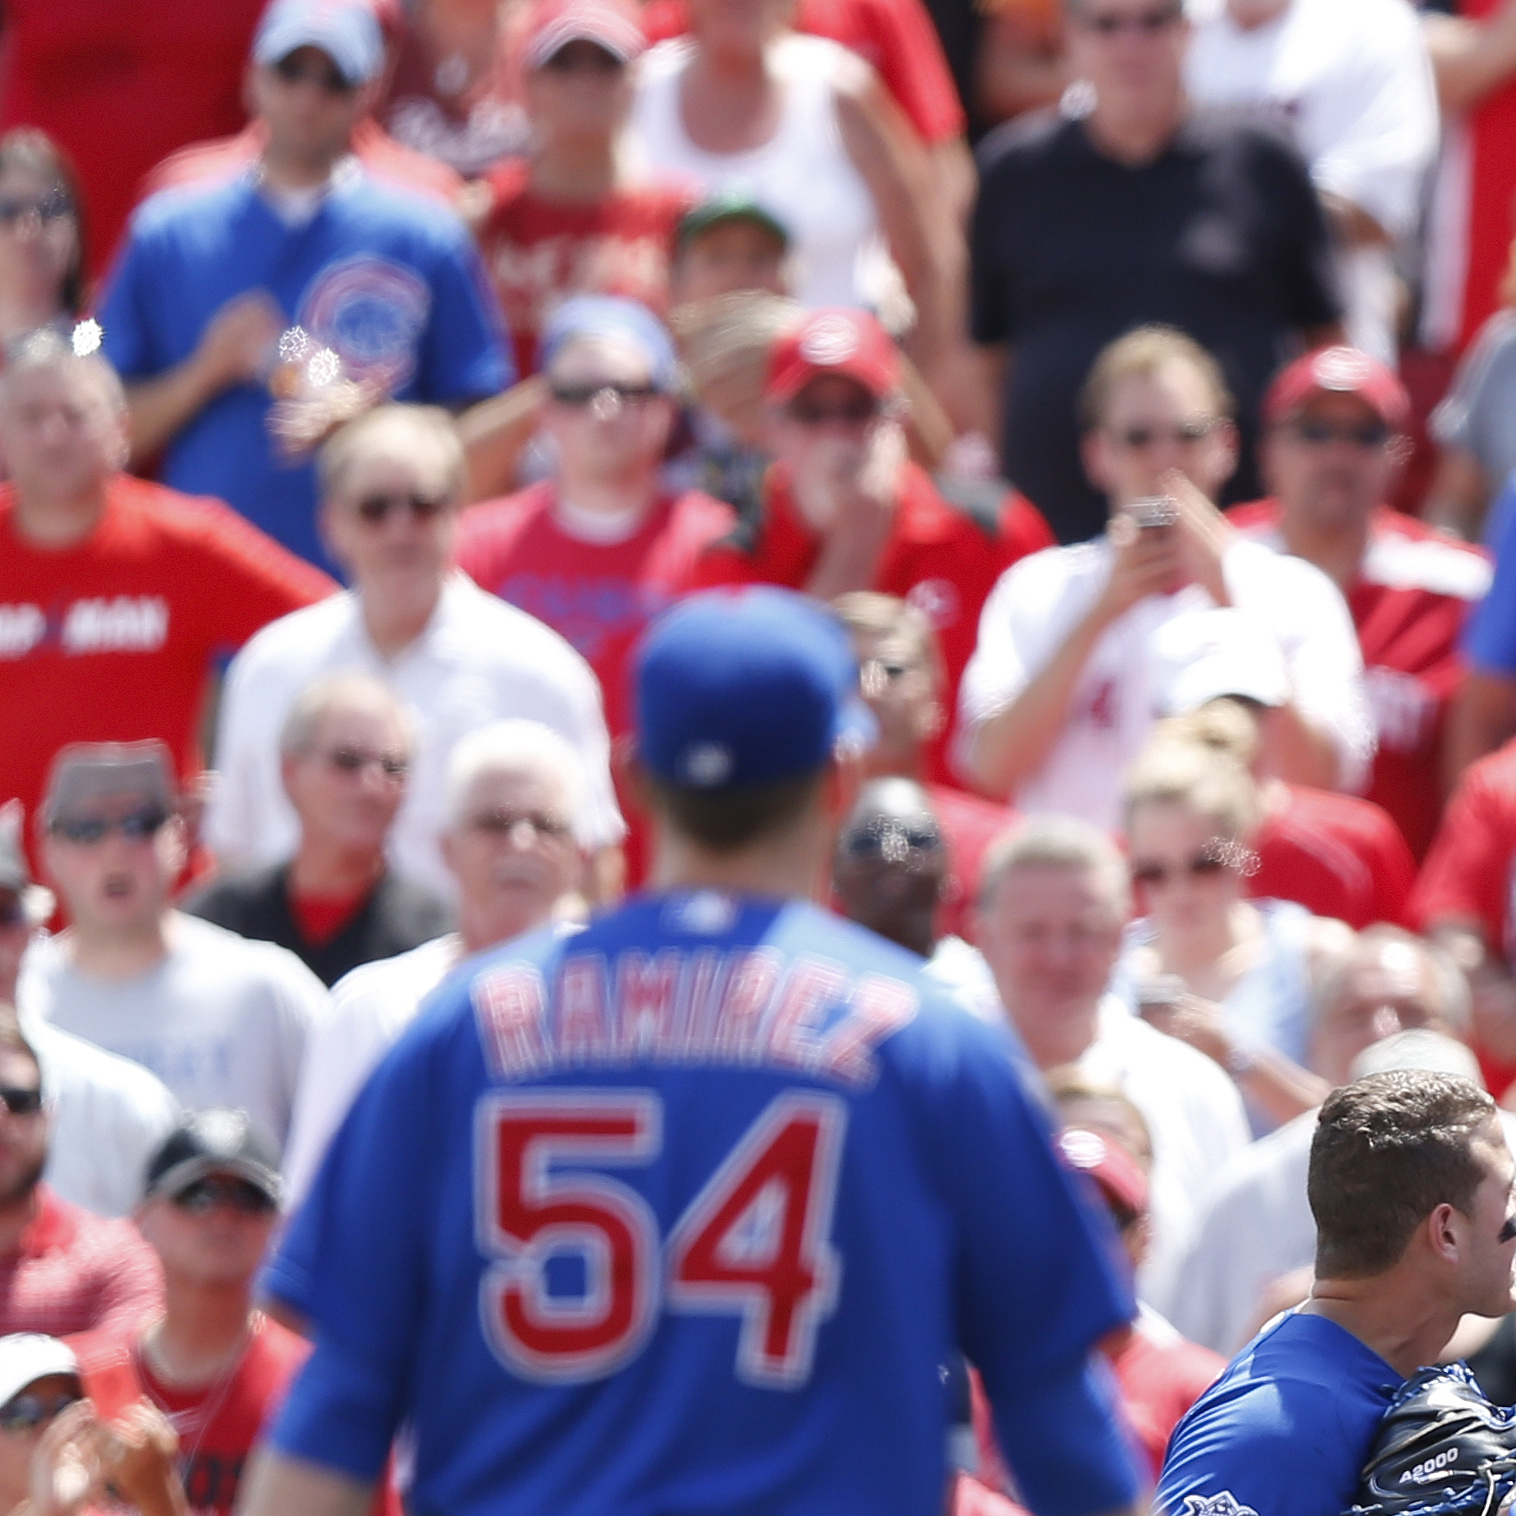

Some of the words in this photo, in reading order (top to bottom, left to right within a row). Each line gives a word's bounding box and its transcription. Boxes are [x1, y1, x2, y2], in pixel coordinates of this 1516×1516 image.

[471, 945, 918, 1092] RAMIREZ
[473, 1086, 850, 1390] 54
[1399, 1447, 1459, 1484] A2000
